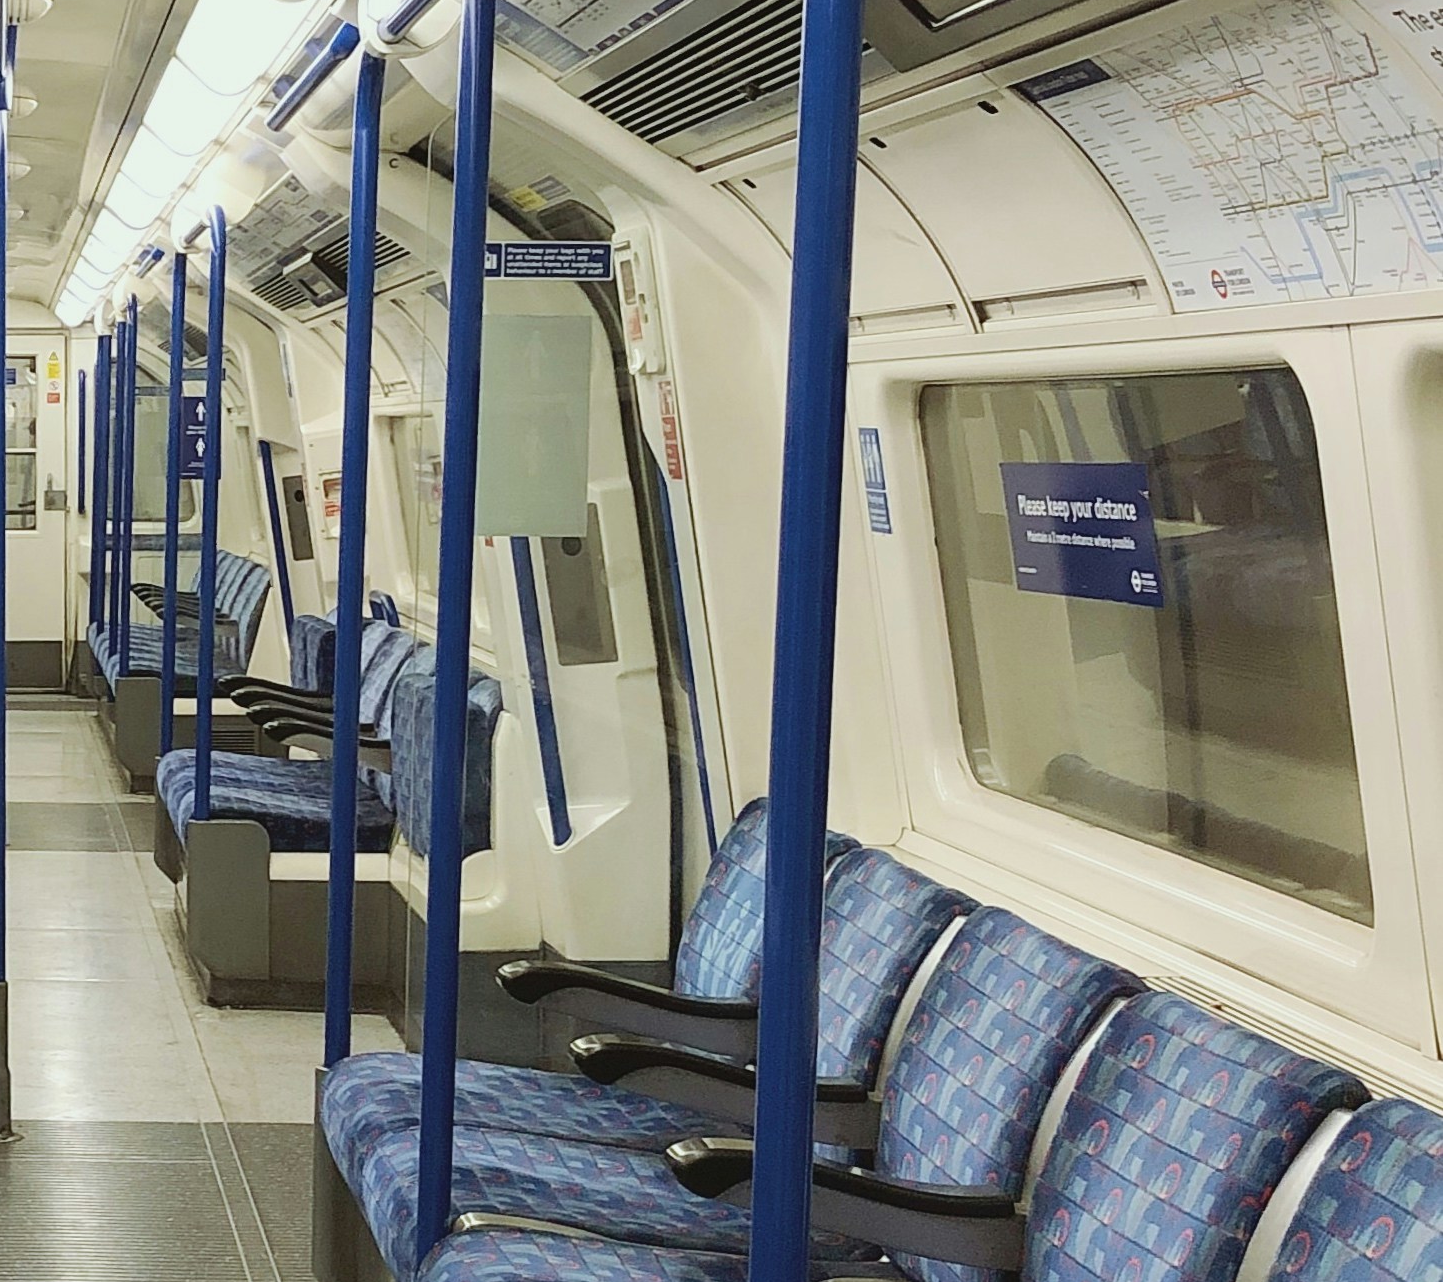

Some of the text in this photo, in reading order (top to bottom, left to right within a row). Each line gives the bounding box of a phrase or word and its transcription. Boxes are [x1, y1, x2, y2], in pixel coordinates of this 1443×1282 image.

[1392, 9, 1435, 33] The
[389, 158, 399, 169] C
[1017, 494, 1138, 523] Please keep your distance
